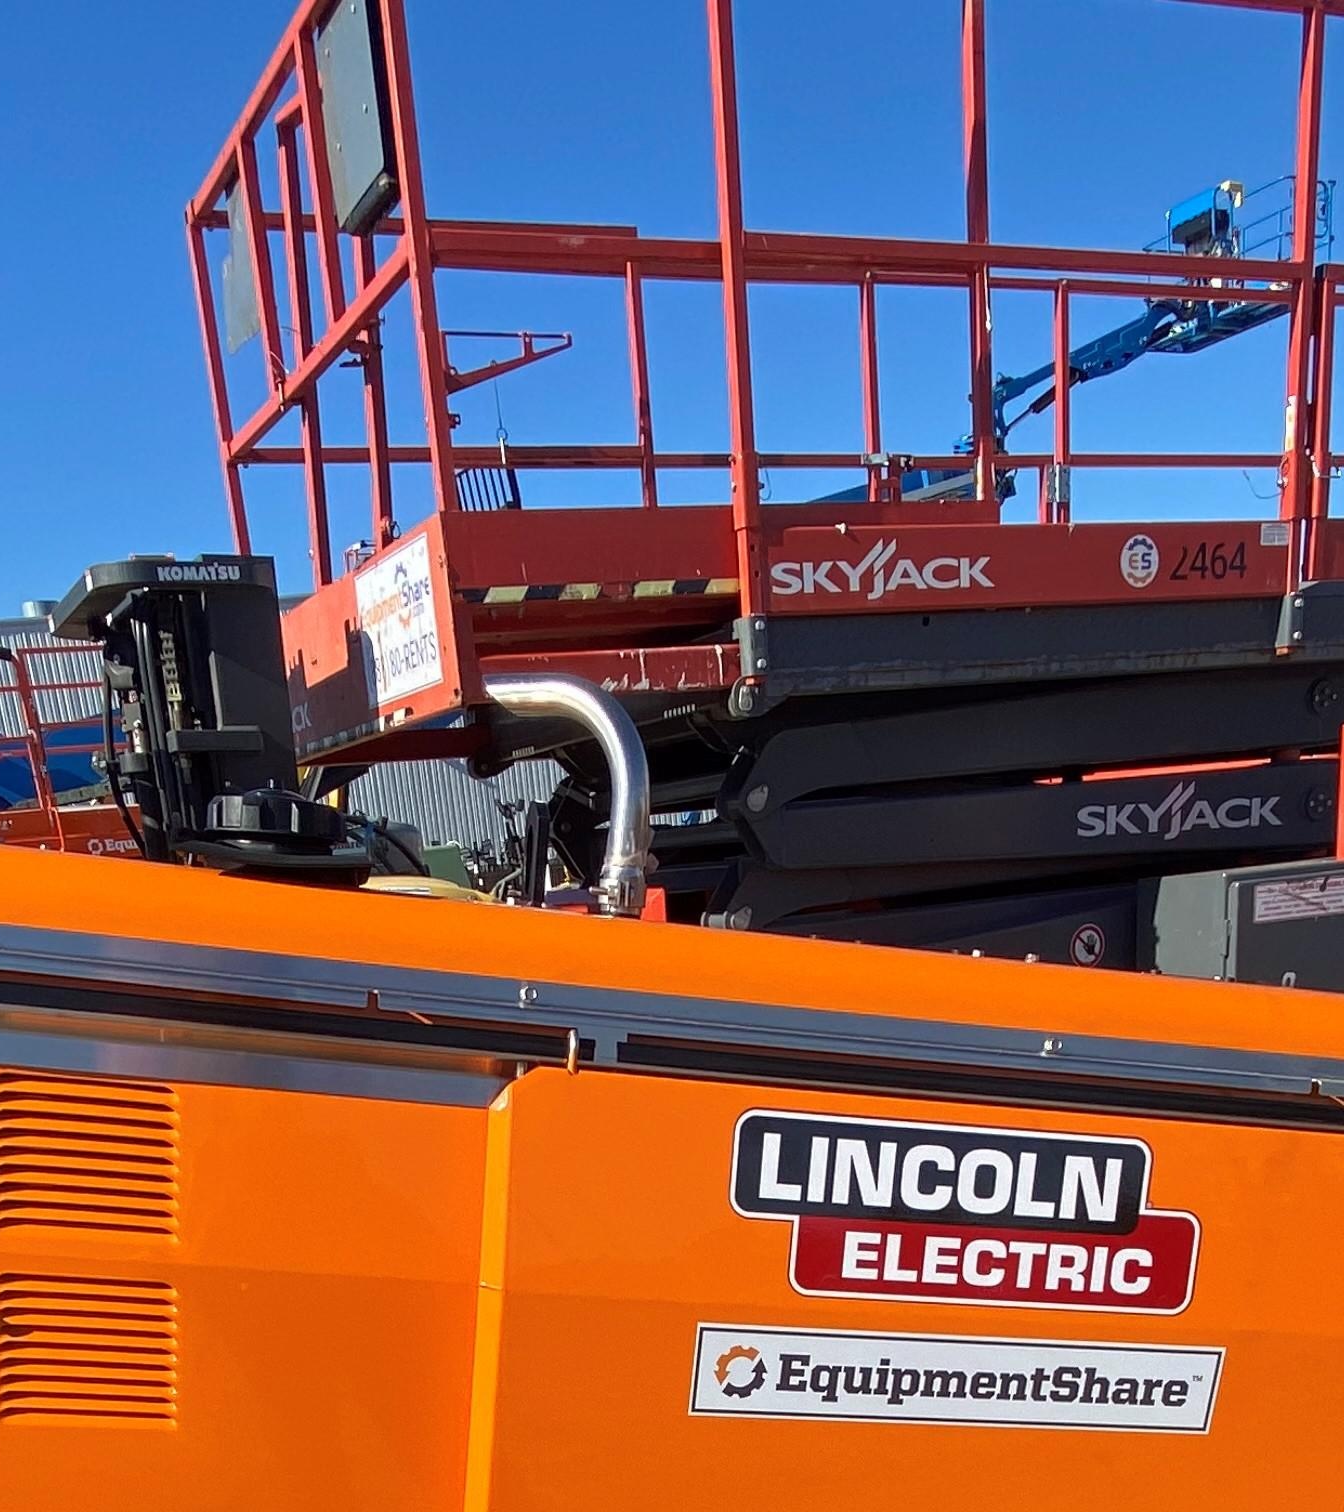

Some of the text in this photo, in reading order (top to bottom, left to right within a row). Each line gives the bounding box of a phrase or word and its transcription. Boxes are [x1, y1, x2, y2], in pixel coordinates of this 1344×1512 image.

[156, 562, 241, 581] KOMATSU
[770, 538, 995, 600] SKYJACK
[1169, 541, 1247, 581] 2464
[1076, 781, 1284, 840] SKYJACK
[758, 1132, 1123, 1222] LINCOLN
[841, 1230, 1153, 1295] ELECTRIC
[775, 1353, 1189, 1409] EquipmentShare
